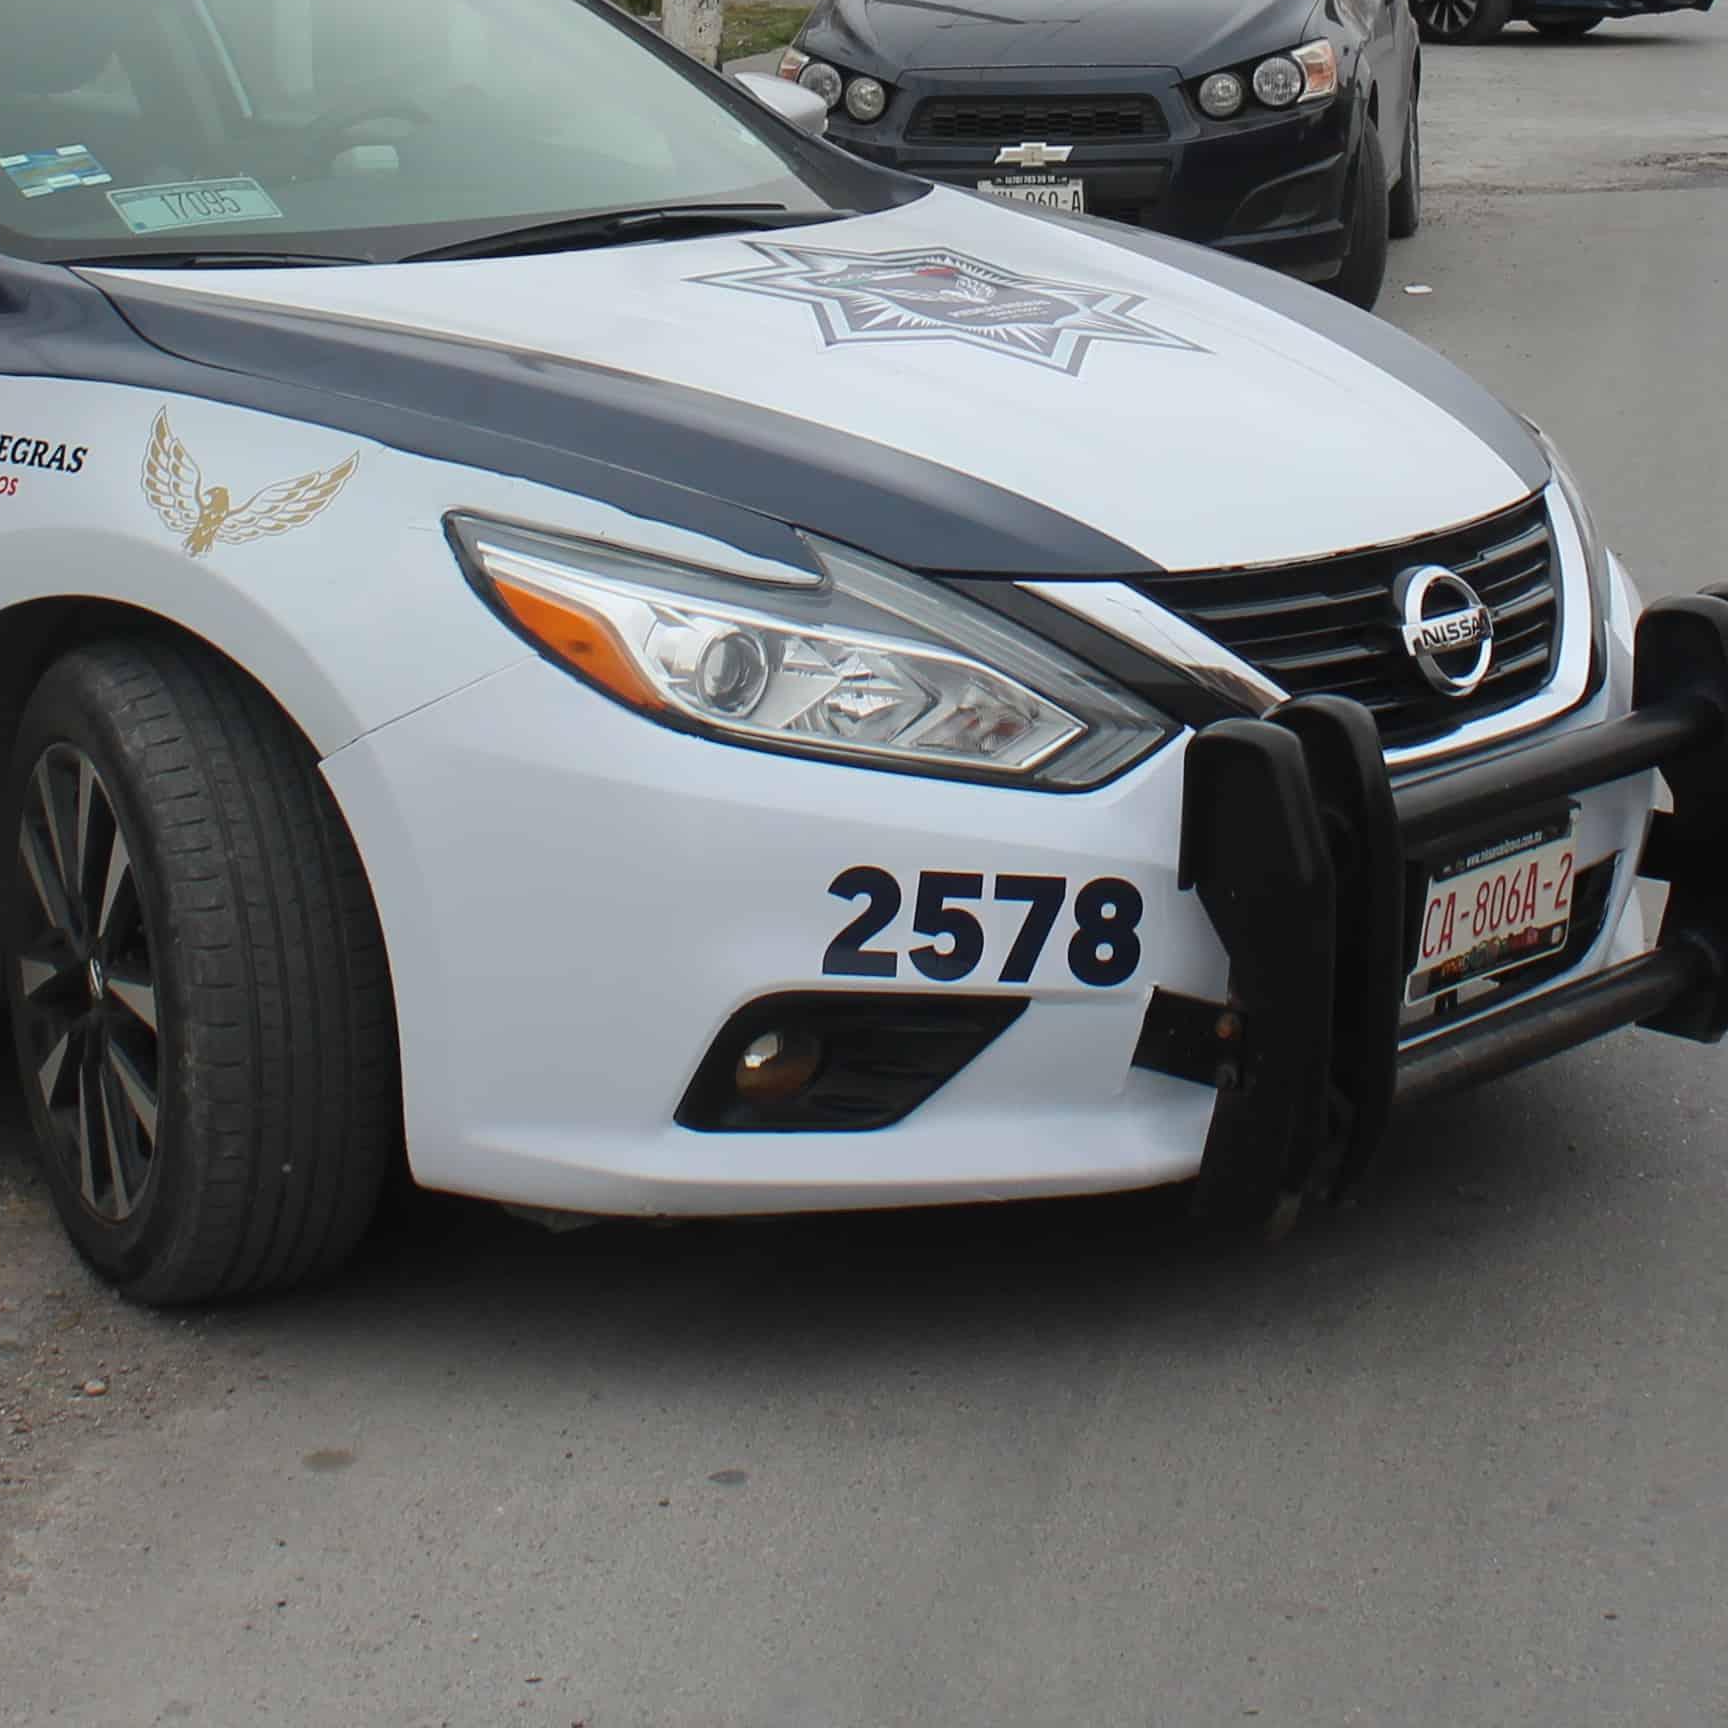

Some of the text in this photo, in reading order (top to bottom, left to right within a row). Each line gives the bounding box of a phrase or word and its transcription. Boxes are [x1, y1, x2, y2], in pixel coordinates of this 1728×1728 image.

[160, 179, 241, 220] 17095
[822, 865, 1143, 987] 2578
[1423, 852, 1574, 958] CA-806A-2
